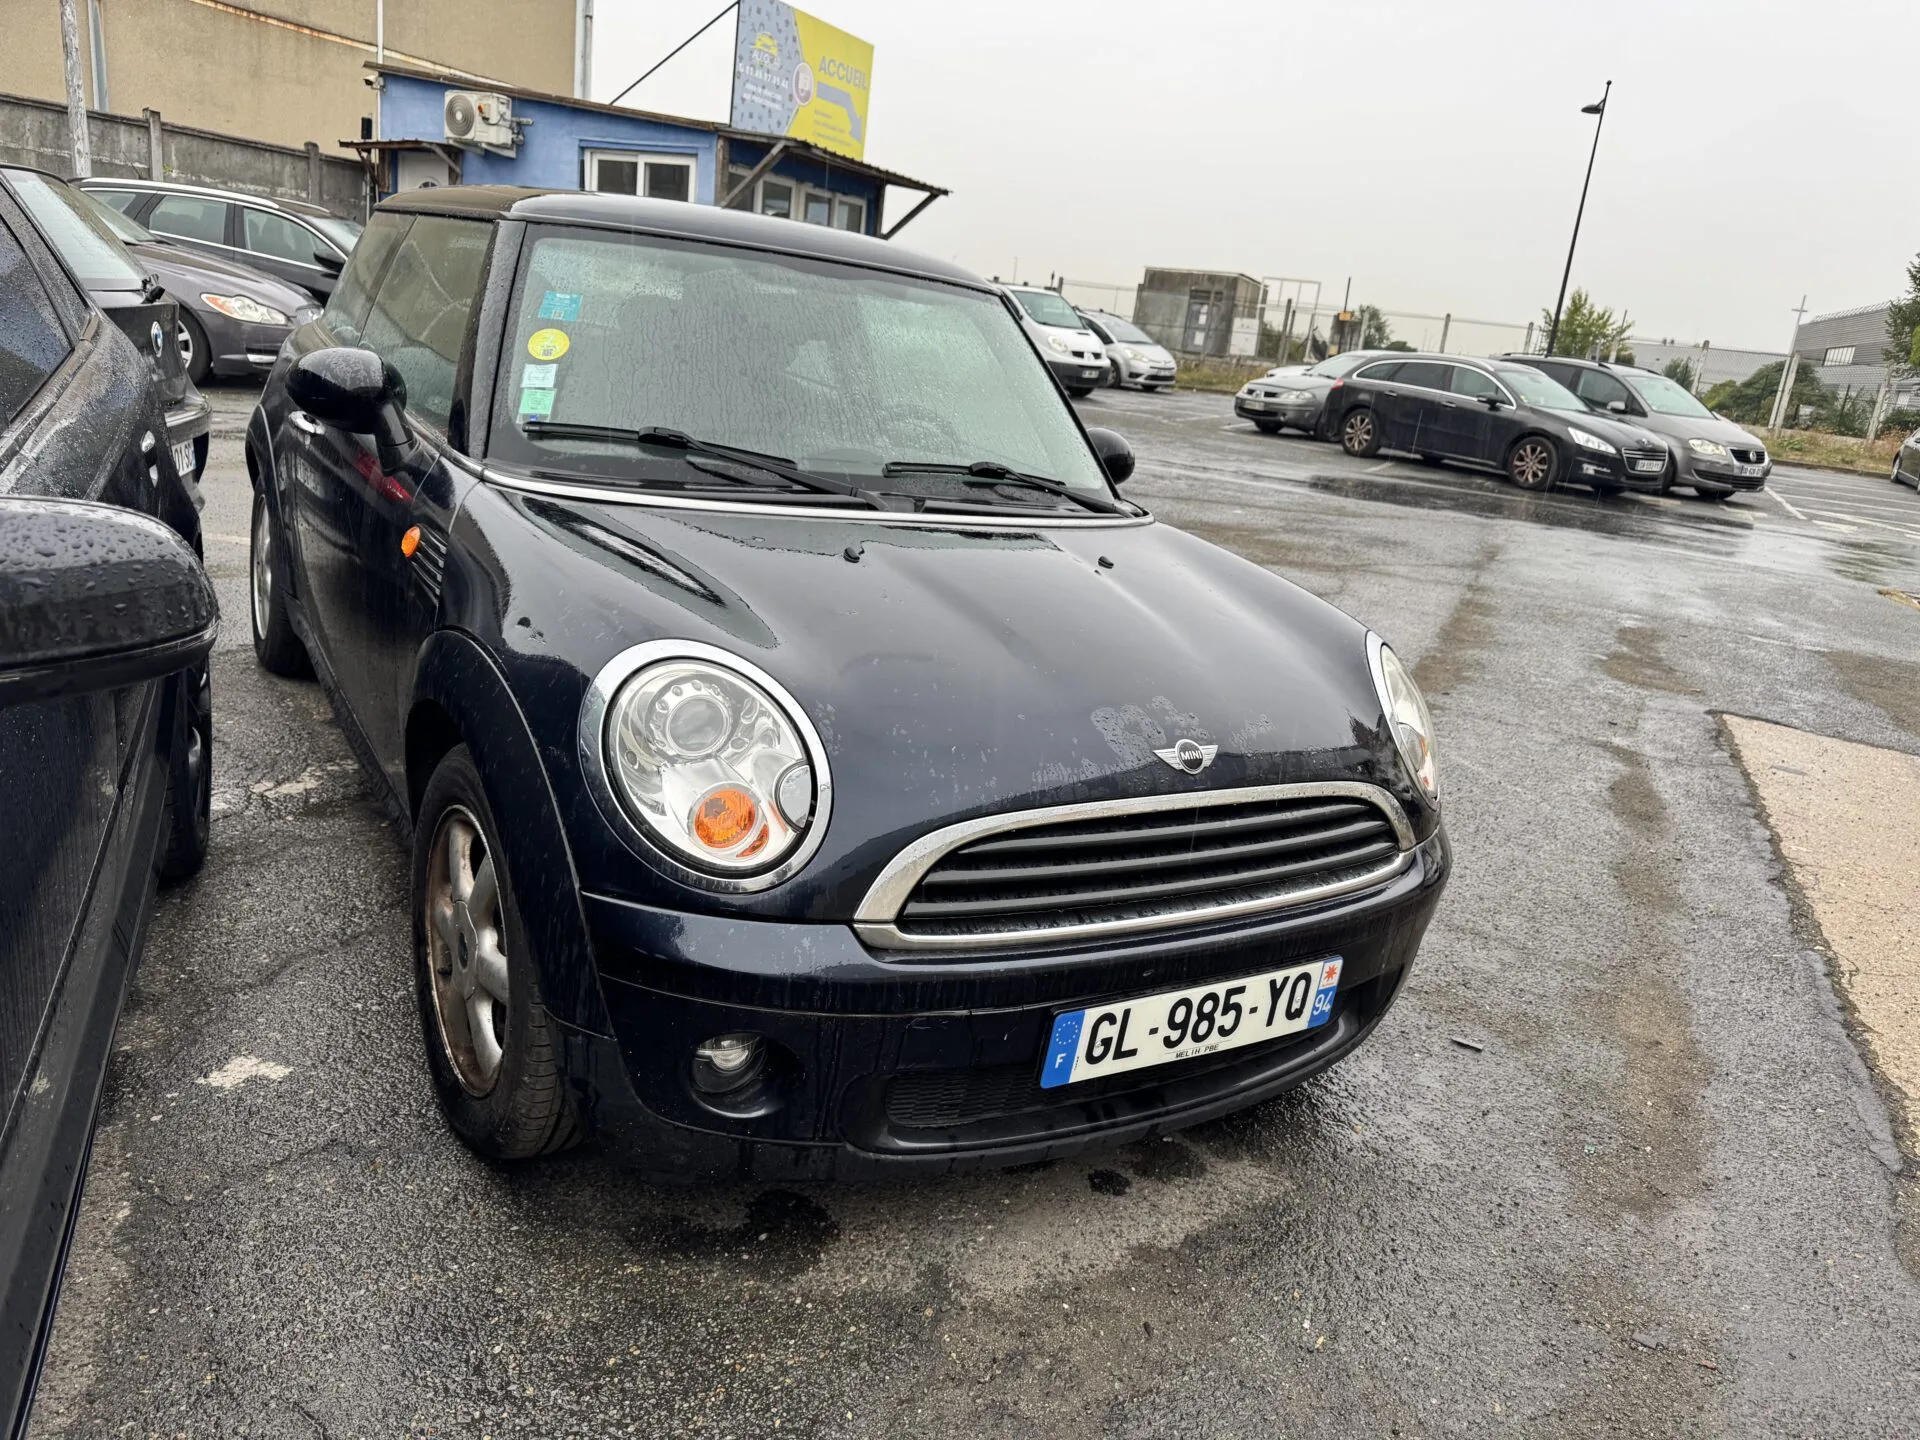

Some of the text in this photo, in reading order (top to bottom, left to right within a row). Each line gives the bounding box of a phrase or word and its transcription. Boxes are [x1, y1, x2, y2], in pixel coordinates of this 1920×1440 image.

[818, 55, 867, 90] ACCUEIL
[1180, 750, 1202, 760] MINI
[1313, 991, 1333, 1015] 94
[1055, 1053, 1067, 1069] F
